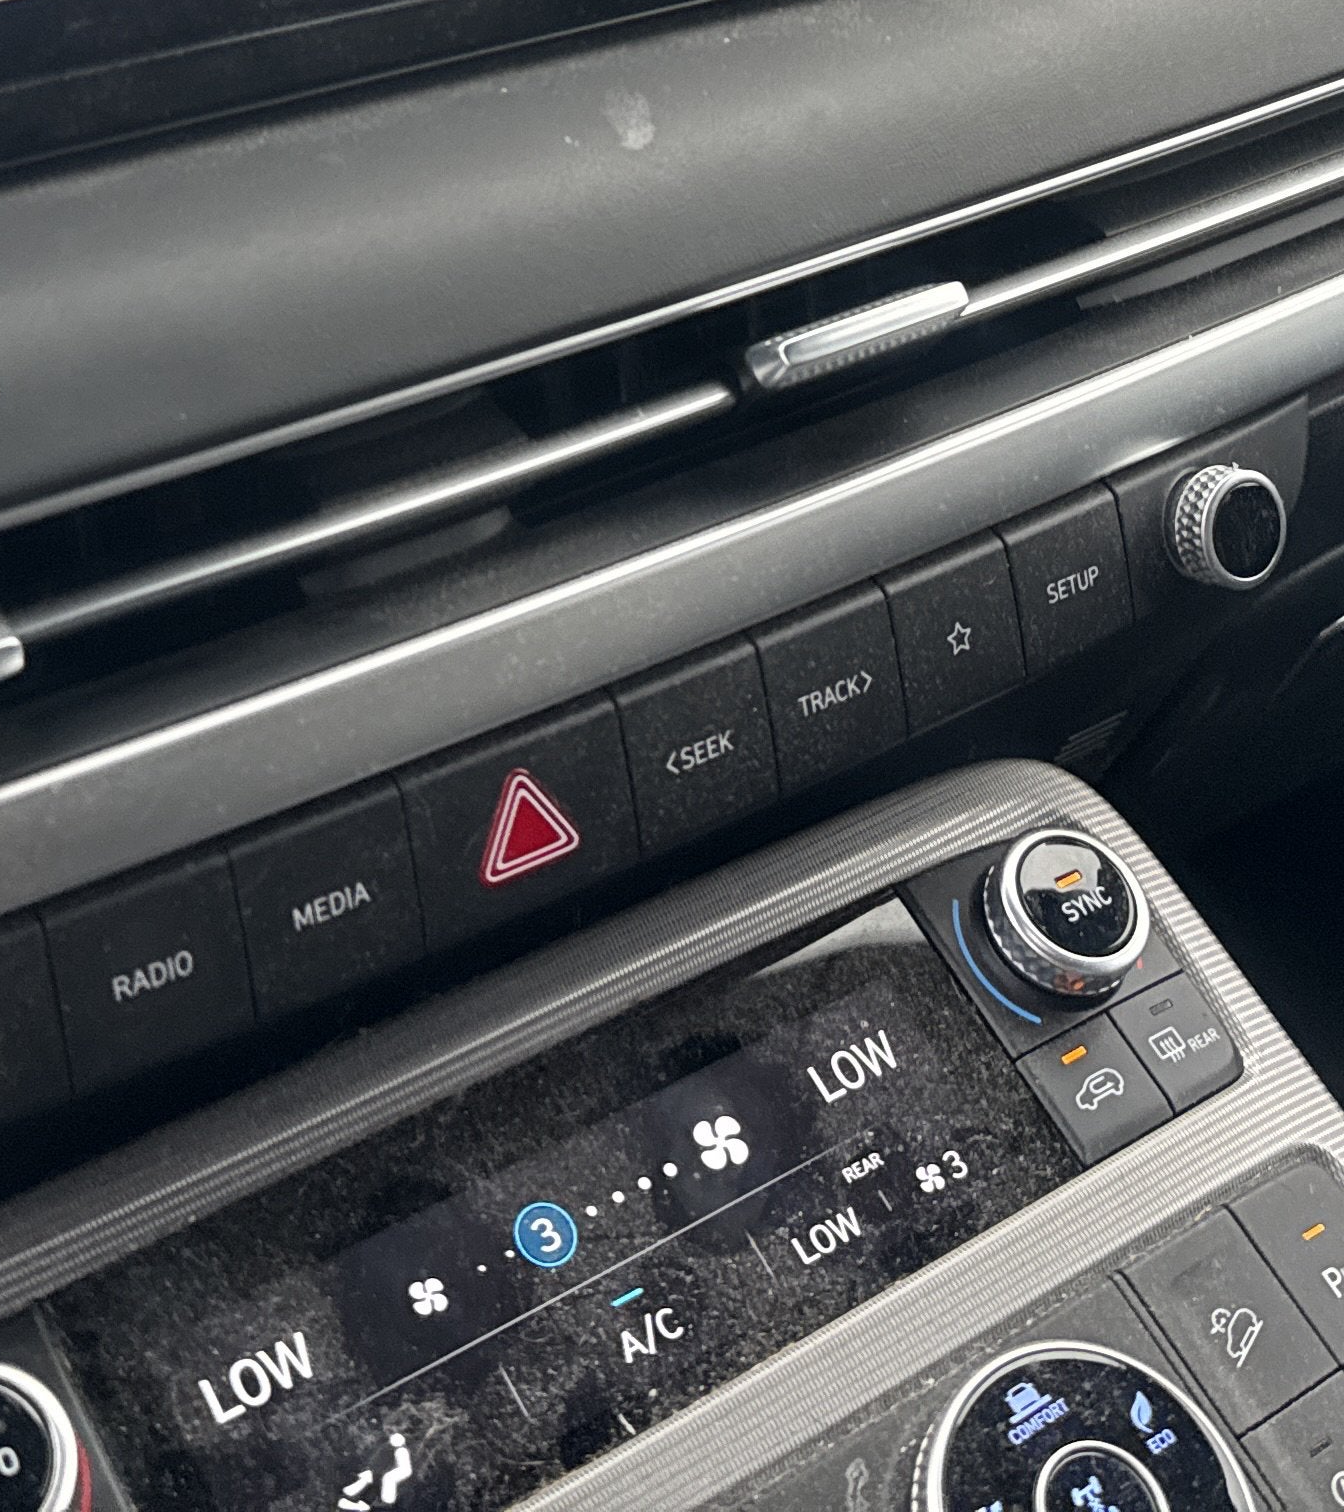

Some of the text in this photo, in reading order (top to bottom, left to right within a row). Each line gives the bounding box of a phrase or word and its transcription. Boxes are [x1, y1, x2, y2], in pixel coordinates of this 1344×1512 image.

[1046, 565, 1101, 605] SETUP
[291, 882, 372, 931] MEDIA
[1061, 886, 1113, 923] SYNC
[111, 950, 195, 1002] RADIO
[1187, 1028, 1221, 1053] REAR
[807, 1029, 897, 1104] LOW
[841, 1152, 885, 1184] REAR
[941, 1150, 969, 1179] 3
[529, 1217, 562, 1253] 3
[790, 1206, 862, 1265] LOW
[620, 1307, 685, 1364] A/C
[198, 1331, 313, 1424] LOW
[1007, 1397, 1071, 1447] COMFORT
[1145, 1428, 1179, 1455] ECO
